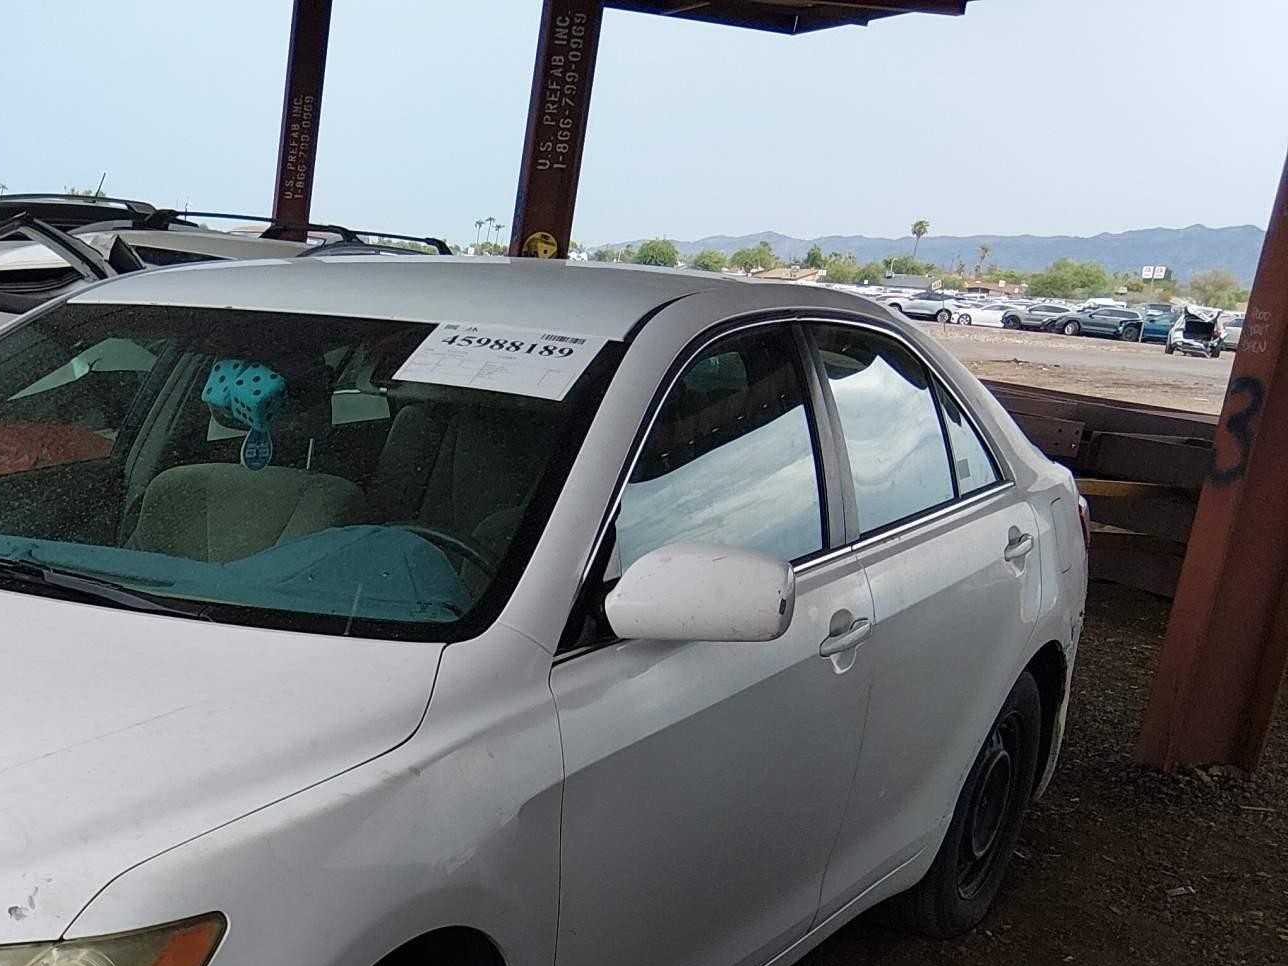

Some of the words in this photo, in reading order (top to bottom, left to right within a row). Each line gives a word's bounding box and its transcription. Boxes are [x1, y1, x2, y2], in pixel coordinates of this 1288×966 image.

[554, 10, 572, 45] INC.
[542, 55, 565, 125] PREFAB
[553, 13, 587, 169] 1-866-799-0969
[287, 123, 300, 170] PREFAB
[536, 136, 554, 170] U.S.
[441, 334, 574, 359] 45988189
